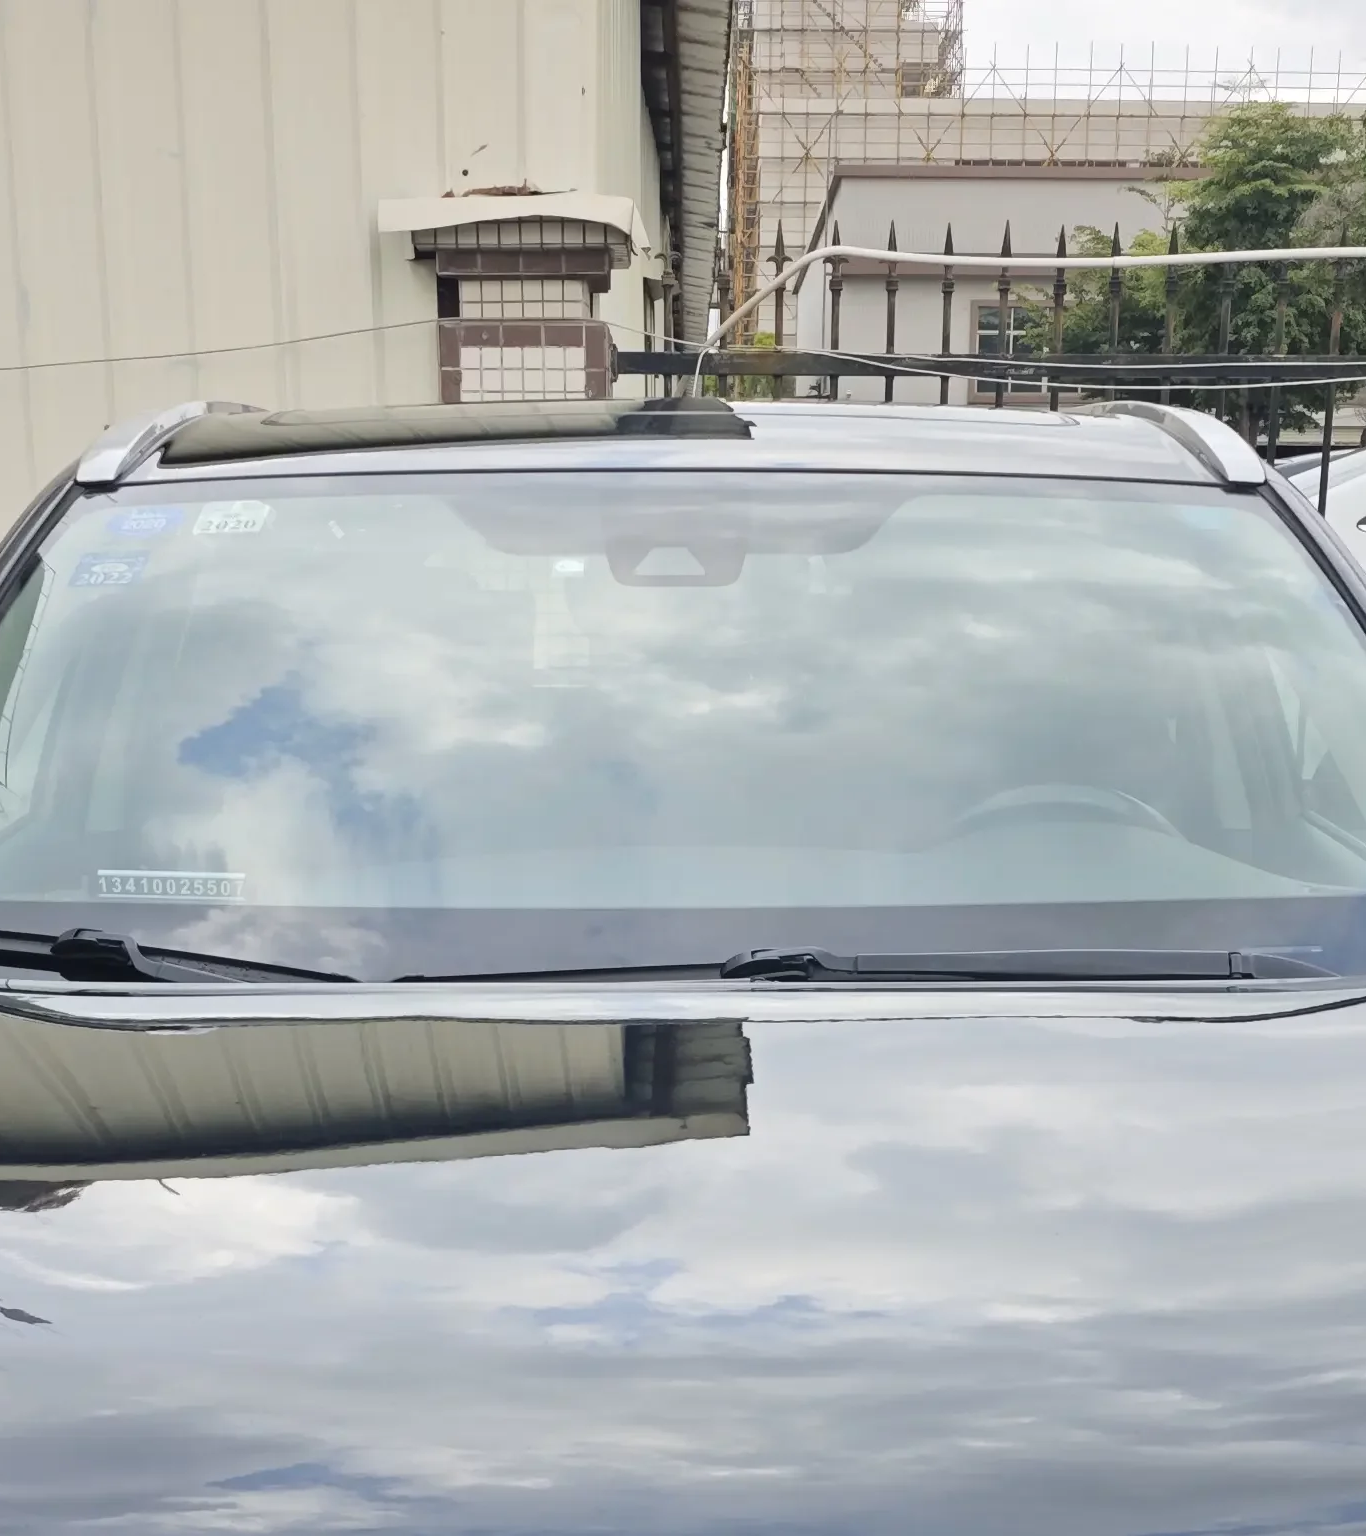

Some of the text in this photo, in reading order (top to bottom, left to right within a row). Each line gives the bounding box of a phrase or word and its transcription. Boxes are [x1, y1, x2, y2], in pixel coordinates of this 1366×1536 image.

[201, 519, 256, 531] 2020
[75, 572, 132, 584] 2022
[98, 876, 244, 897] 13410025507
